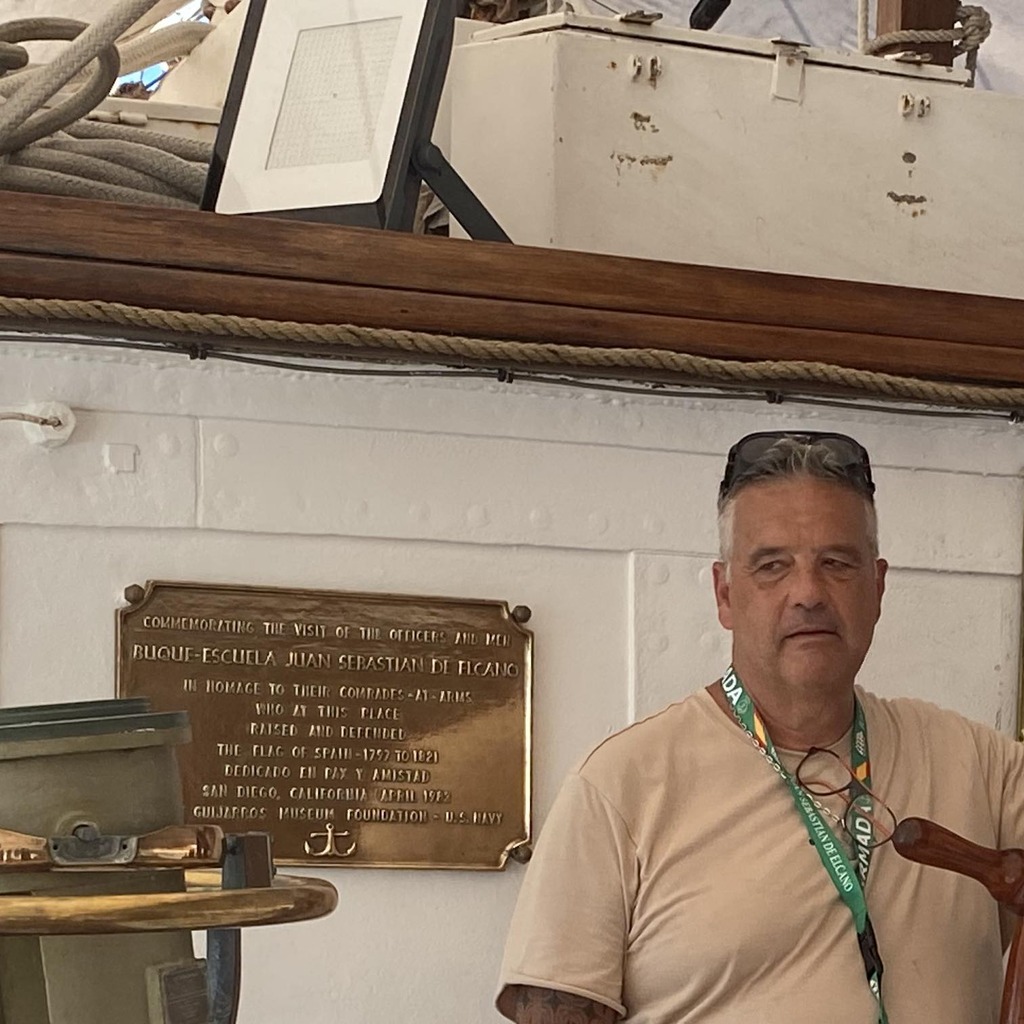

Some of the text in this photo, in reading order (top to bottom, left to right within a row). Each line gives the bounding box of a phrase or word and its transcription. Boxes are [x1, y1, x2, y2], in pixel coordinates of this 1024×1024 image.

[143, 616, 255, 633] COMMEMORATING
[263, 621, 286, 635] THE
[294, 622, 326, 638] VISIT
[335, 626, 350, 638] OF
[360, 627, 382, 640] THE
[389, 628, 447, 643] OFFICERS
[454, 631, 478, 645] AND
[132, 643, 520, 677] BUQUE-ESCUELA JUAN SEBASTIAN DE ELCANO
[183, 679, 197, 692] IN
[206, 679, 260, 695] HOMAGE
[268, 682, 285, 696] TO
[293, 683, 331, 697] THEIR
[255, 702, 400, 720] WHO AT THIS PLACE
[250, 722, 407, 741] RAISED AND DEFENDED
[217, 743, 241, 757] THE
[252, 744, 284, 758] FLAG
[292, 746, 307, 758] OF
[395, 749, 409, 762] TO
[224, 764, 291, 778] DEDICADO
[299, 766, 317, 779] EN
[372, 768, 430, 783] AMISTAD
[202, 784, 228, 798] SAN
[289, 786, 367, 801] CALIFORNIA
[278, 806, 335, 820] MUSEUM
[346, 808, 428, 823] FOUNDATION
[829, 855, 854, 892] ELCANO
